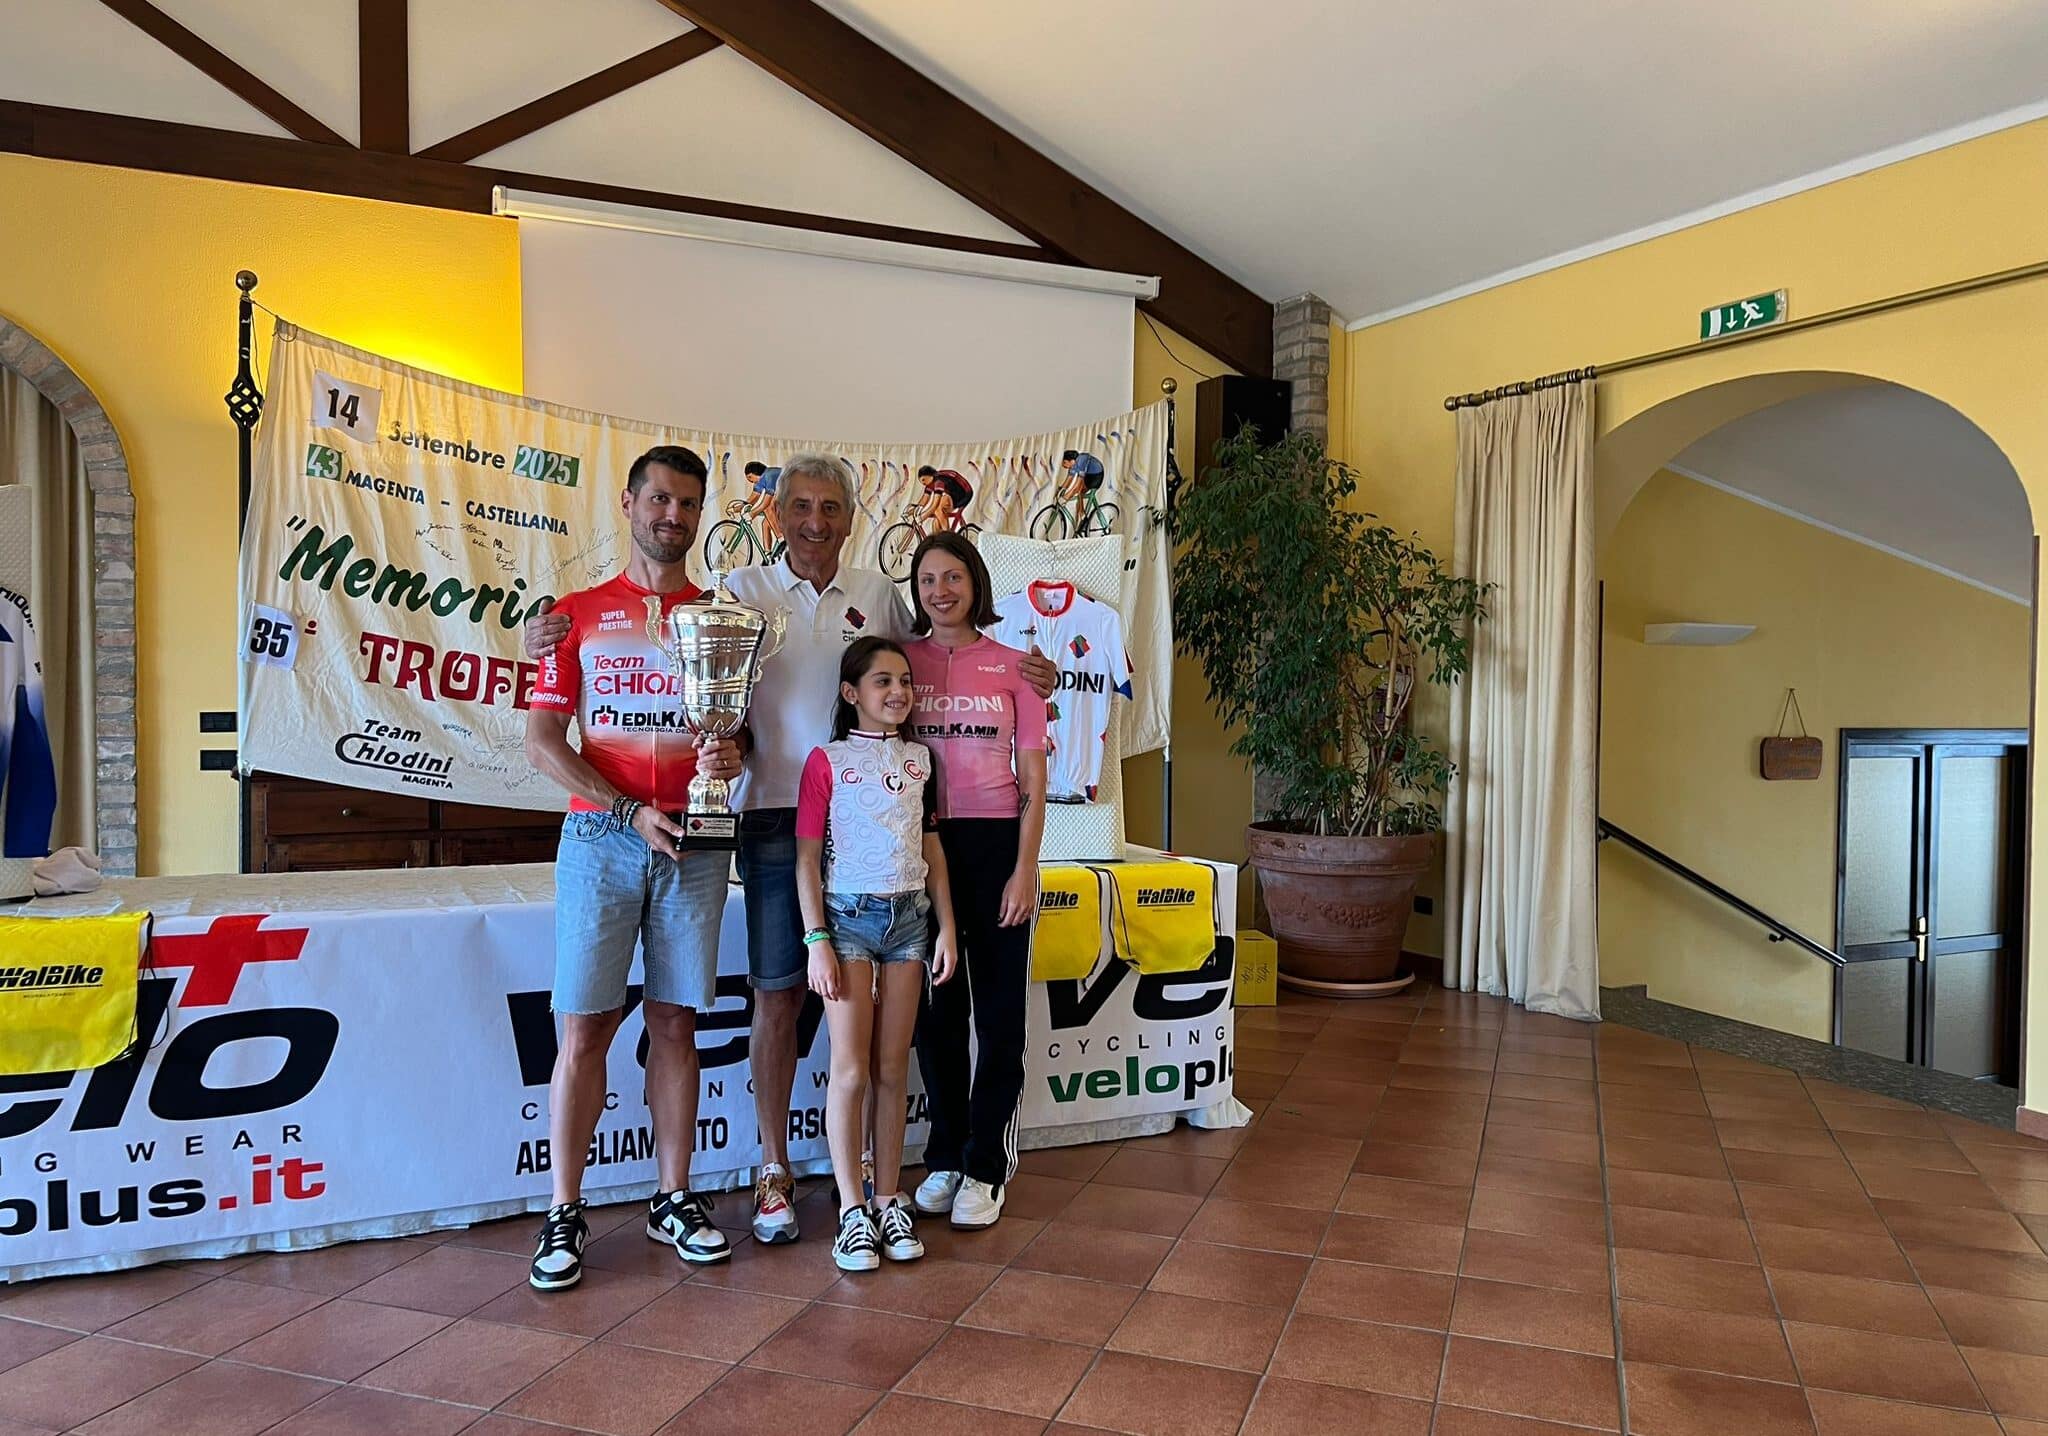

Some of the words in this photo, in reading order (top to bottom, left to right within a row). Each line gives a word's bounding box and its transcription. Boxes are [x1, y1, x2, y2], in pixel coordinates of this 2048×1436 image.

[327, 387, 360, 429] 14
[388, 421, 506, 469] Settembre
[513, 446, 572, 485] 2025
[307, 445, 340, 478] 43
[345, 469, 425, 505] MAGENTA
[465, 500, 569, 536] CASTELLANIA
[598, 620, 633, 632] PRESTIGE
[601, 610, 626, 621] SUPER
[249, 618, 293, 658] 35
[593, 655, 645, 670] Team
[914, 695, 1004, 713] HIODINI
[364, 718, 421, 743] Team
[402, 774, 453, 789] MAGENTA
[1040, 890, 1079, 908] lBike
[1137, 887, 1196, 905] WalBike
[0, 965, 104, 989] WalBike
[1048, 1026, 1225, 1058] CYCLING
[1047, 1044, 1233, 1103] velopl
[125, 1123, 303, 1164] WEAR
